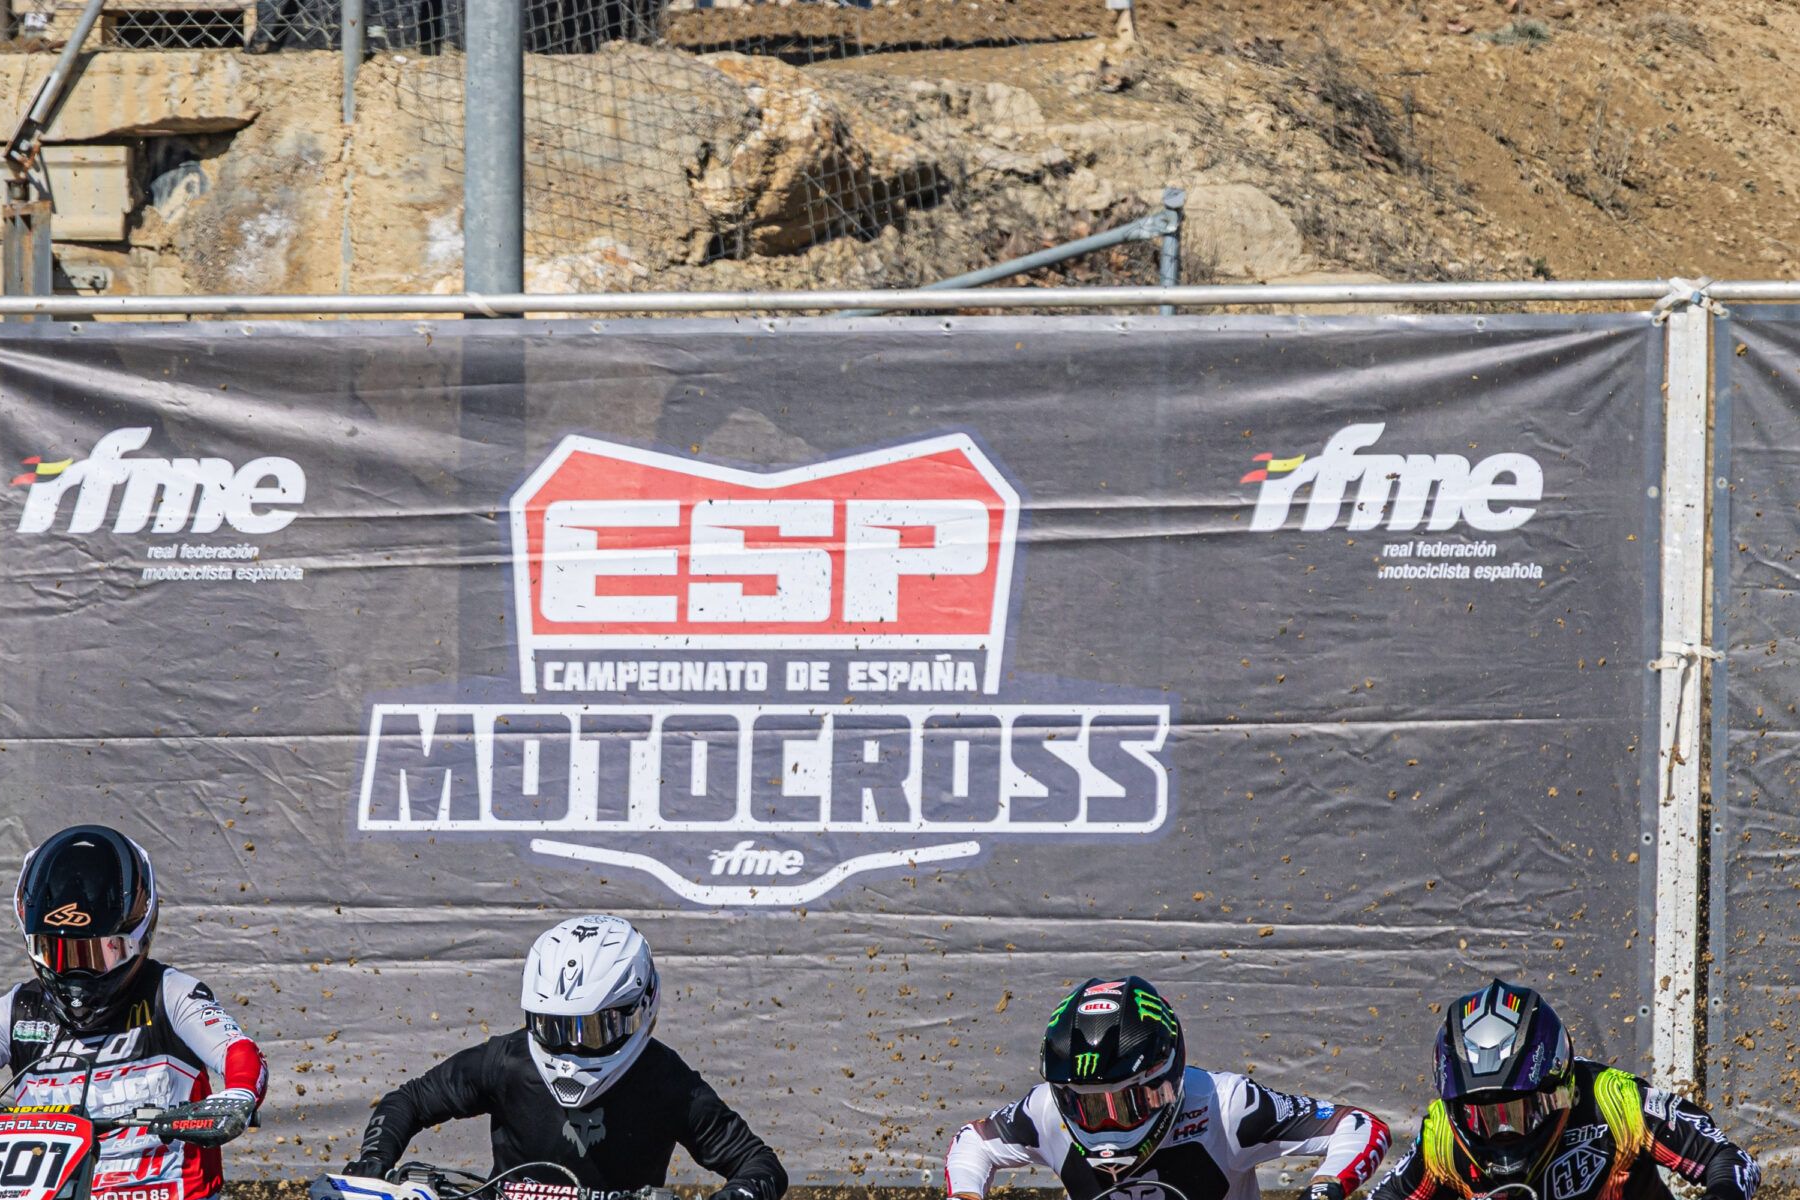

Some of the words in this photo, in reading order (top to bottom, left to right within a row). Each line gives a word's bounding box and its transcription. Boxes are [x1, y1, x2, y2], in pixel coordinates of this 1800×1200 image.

[16, 426, 306, 534] rfme
[1248, 422, 1544, 532] rfme
[147, 544, 177, 558] real
[180, 542, 259, 560] federación
[1383, 544, 1412, 558] real
[1416, 541, 1496, 558] federación
[538, 498, 990, 624] ESP
[142, 565, 232, 580] motociclista
[236, 566, 303, 581] española
[1475, 566, 1543, 580] española
[544, 660, 766, 692] CAMPEONATO
[786, 661, 830, 692] DE
[847, 653, 978, 692] ESPAÑA
[358, 704, 1172, 833] MOTOCROSS
[708, 840, 804, 878] rfme
[1084, 1003, 1113, 1011] BELL
[17, 1120, 77, 1133] OLIVER
[172, 1118, 215, 1130] CIRCUIT
[1172, 1117, 1209, 1142] HRC
[111, 1134, 160, 1149] RACIN
[1565, 1123, 1608, 1147] Bihr
